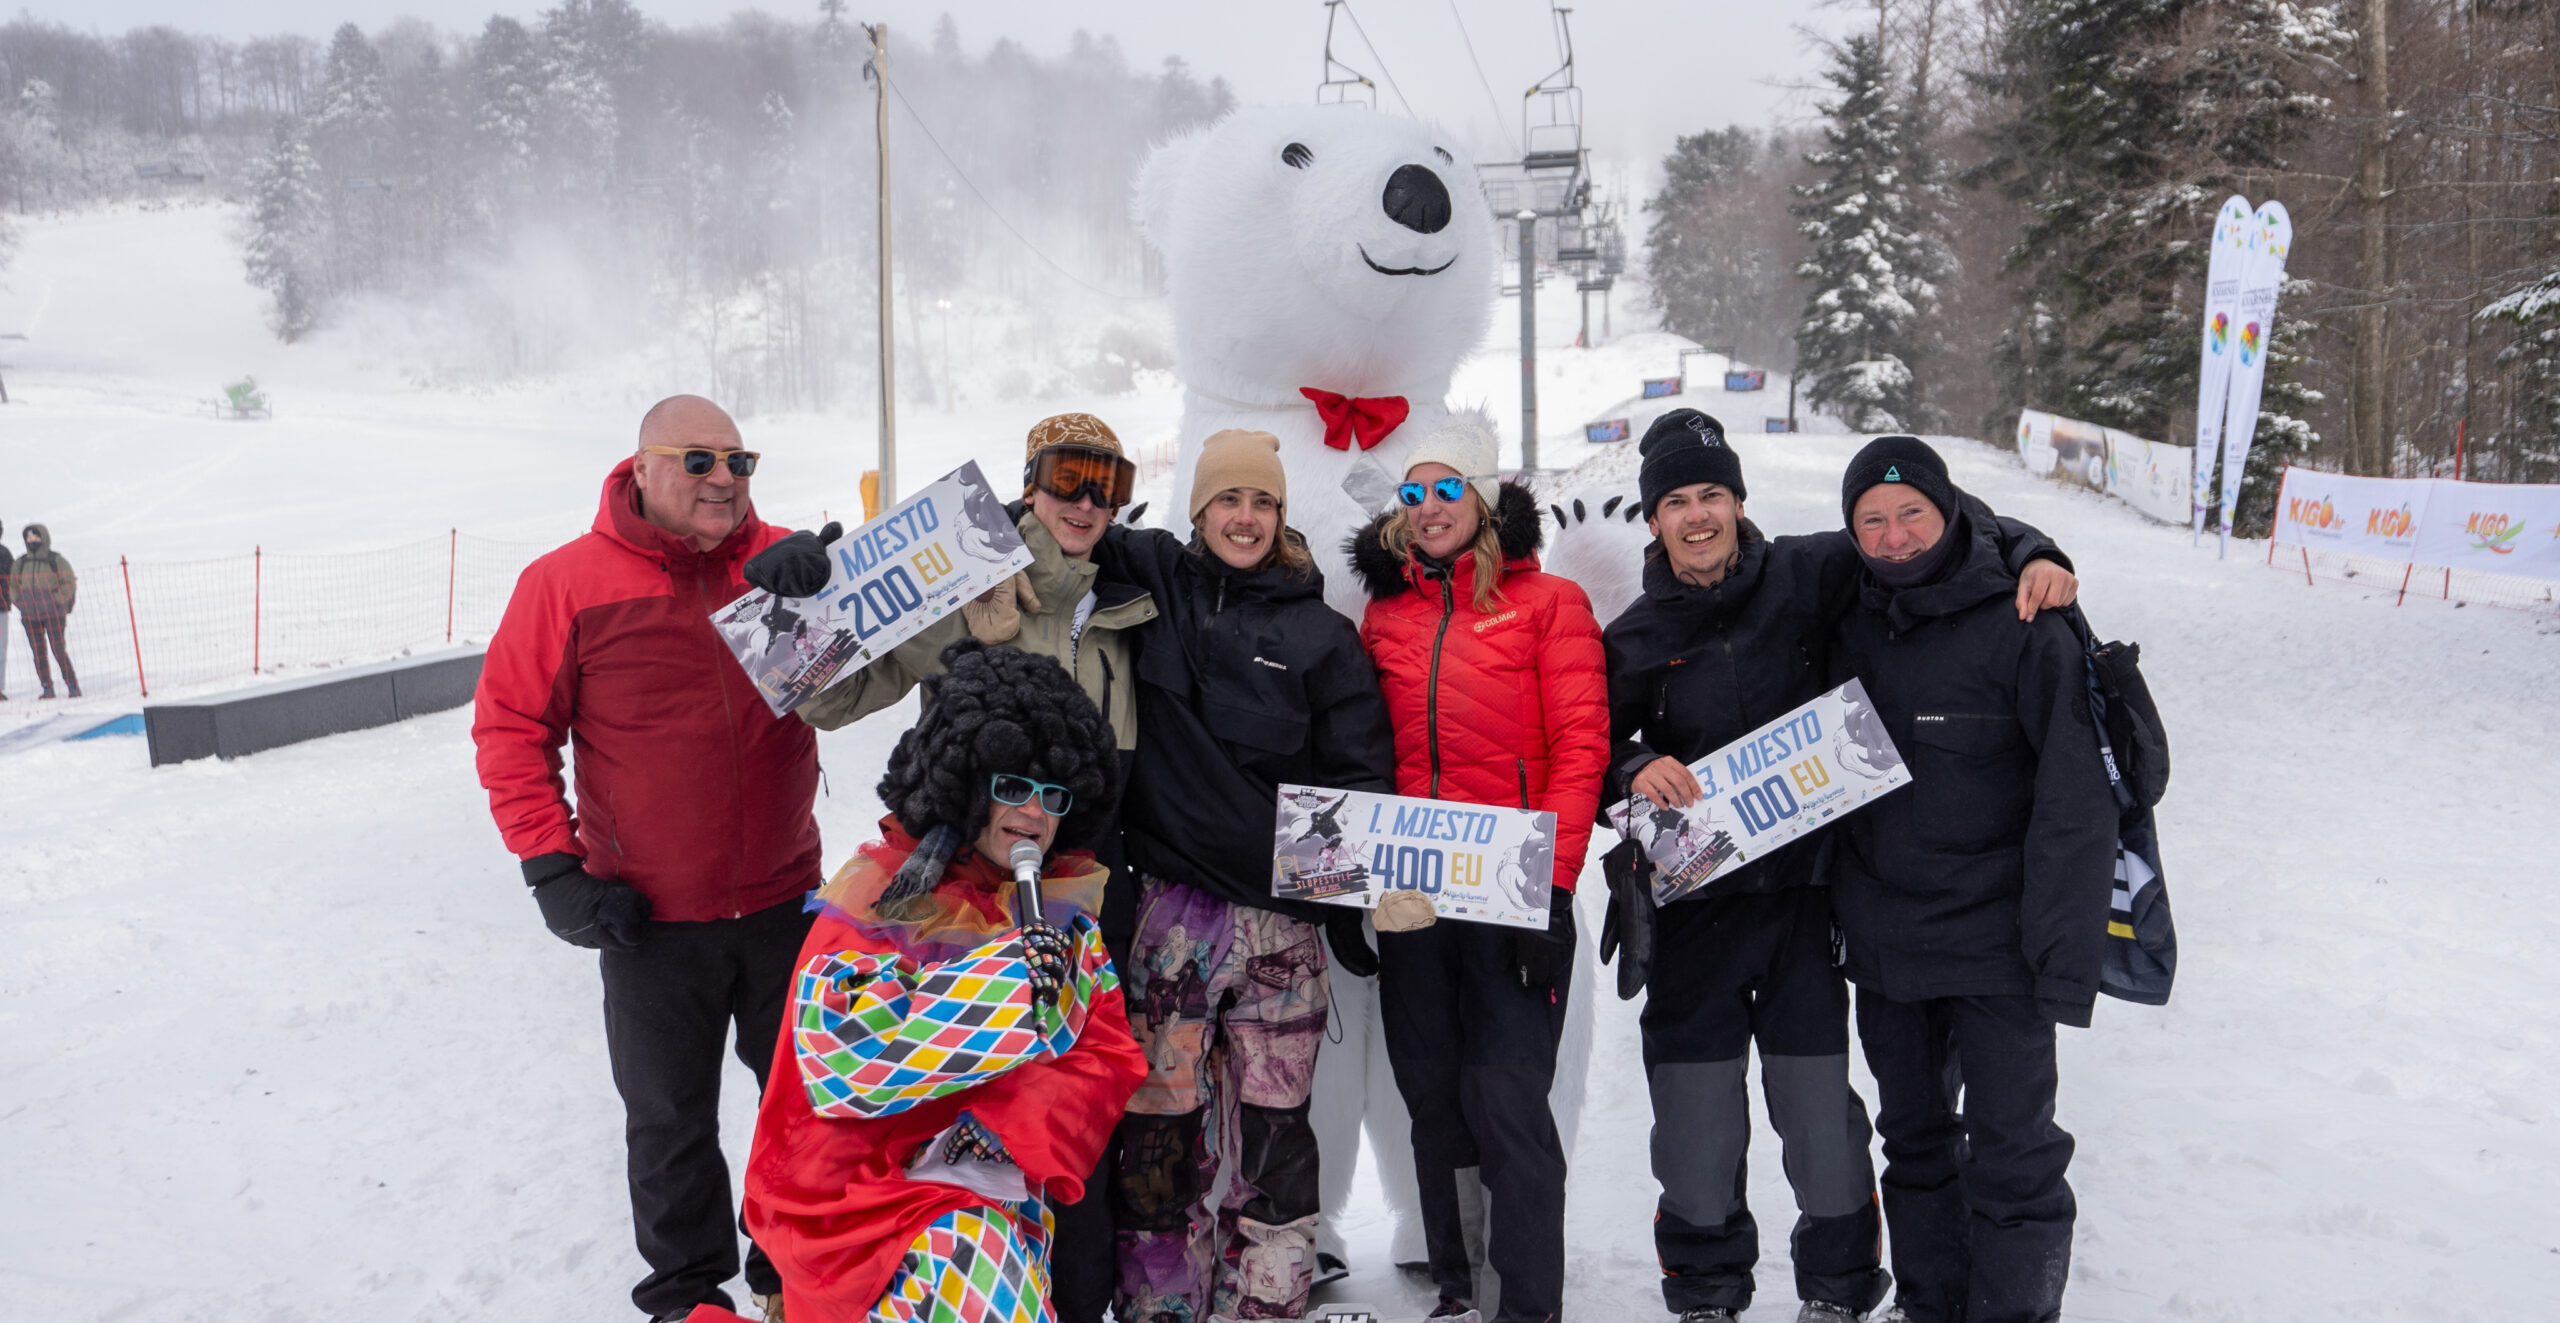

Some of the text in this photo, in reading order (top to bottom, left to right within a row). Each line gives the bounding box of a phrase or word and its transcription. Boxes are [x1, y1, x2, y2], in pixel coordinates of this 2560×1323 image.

[839, 497, 940, 581] MJESTO
[2465, 511, 2509, 536] KIGO
[838, 565, 923, 641] 200
[911, 542, 954, 585] EU
[792, 644, 840, 694] SLOPESTYLE
[1696, 709, 1823, 800] 3. MJESTO
[1730, 774, 1799, 837] 100
[1789, 755, 1830, 796] EU
[1392, 805, 1497, 845] MJESTO
[1296, 872, 1352, 890] SLOPESTYLE
[1371, 843, 1483, 894] 400 EU
[1671, 844, 1718, 887] SLOPESTYLE
